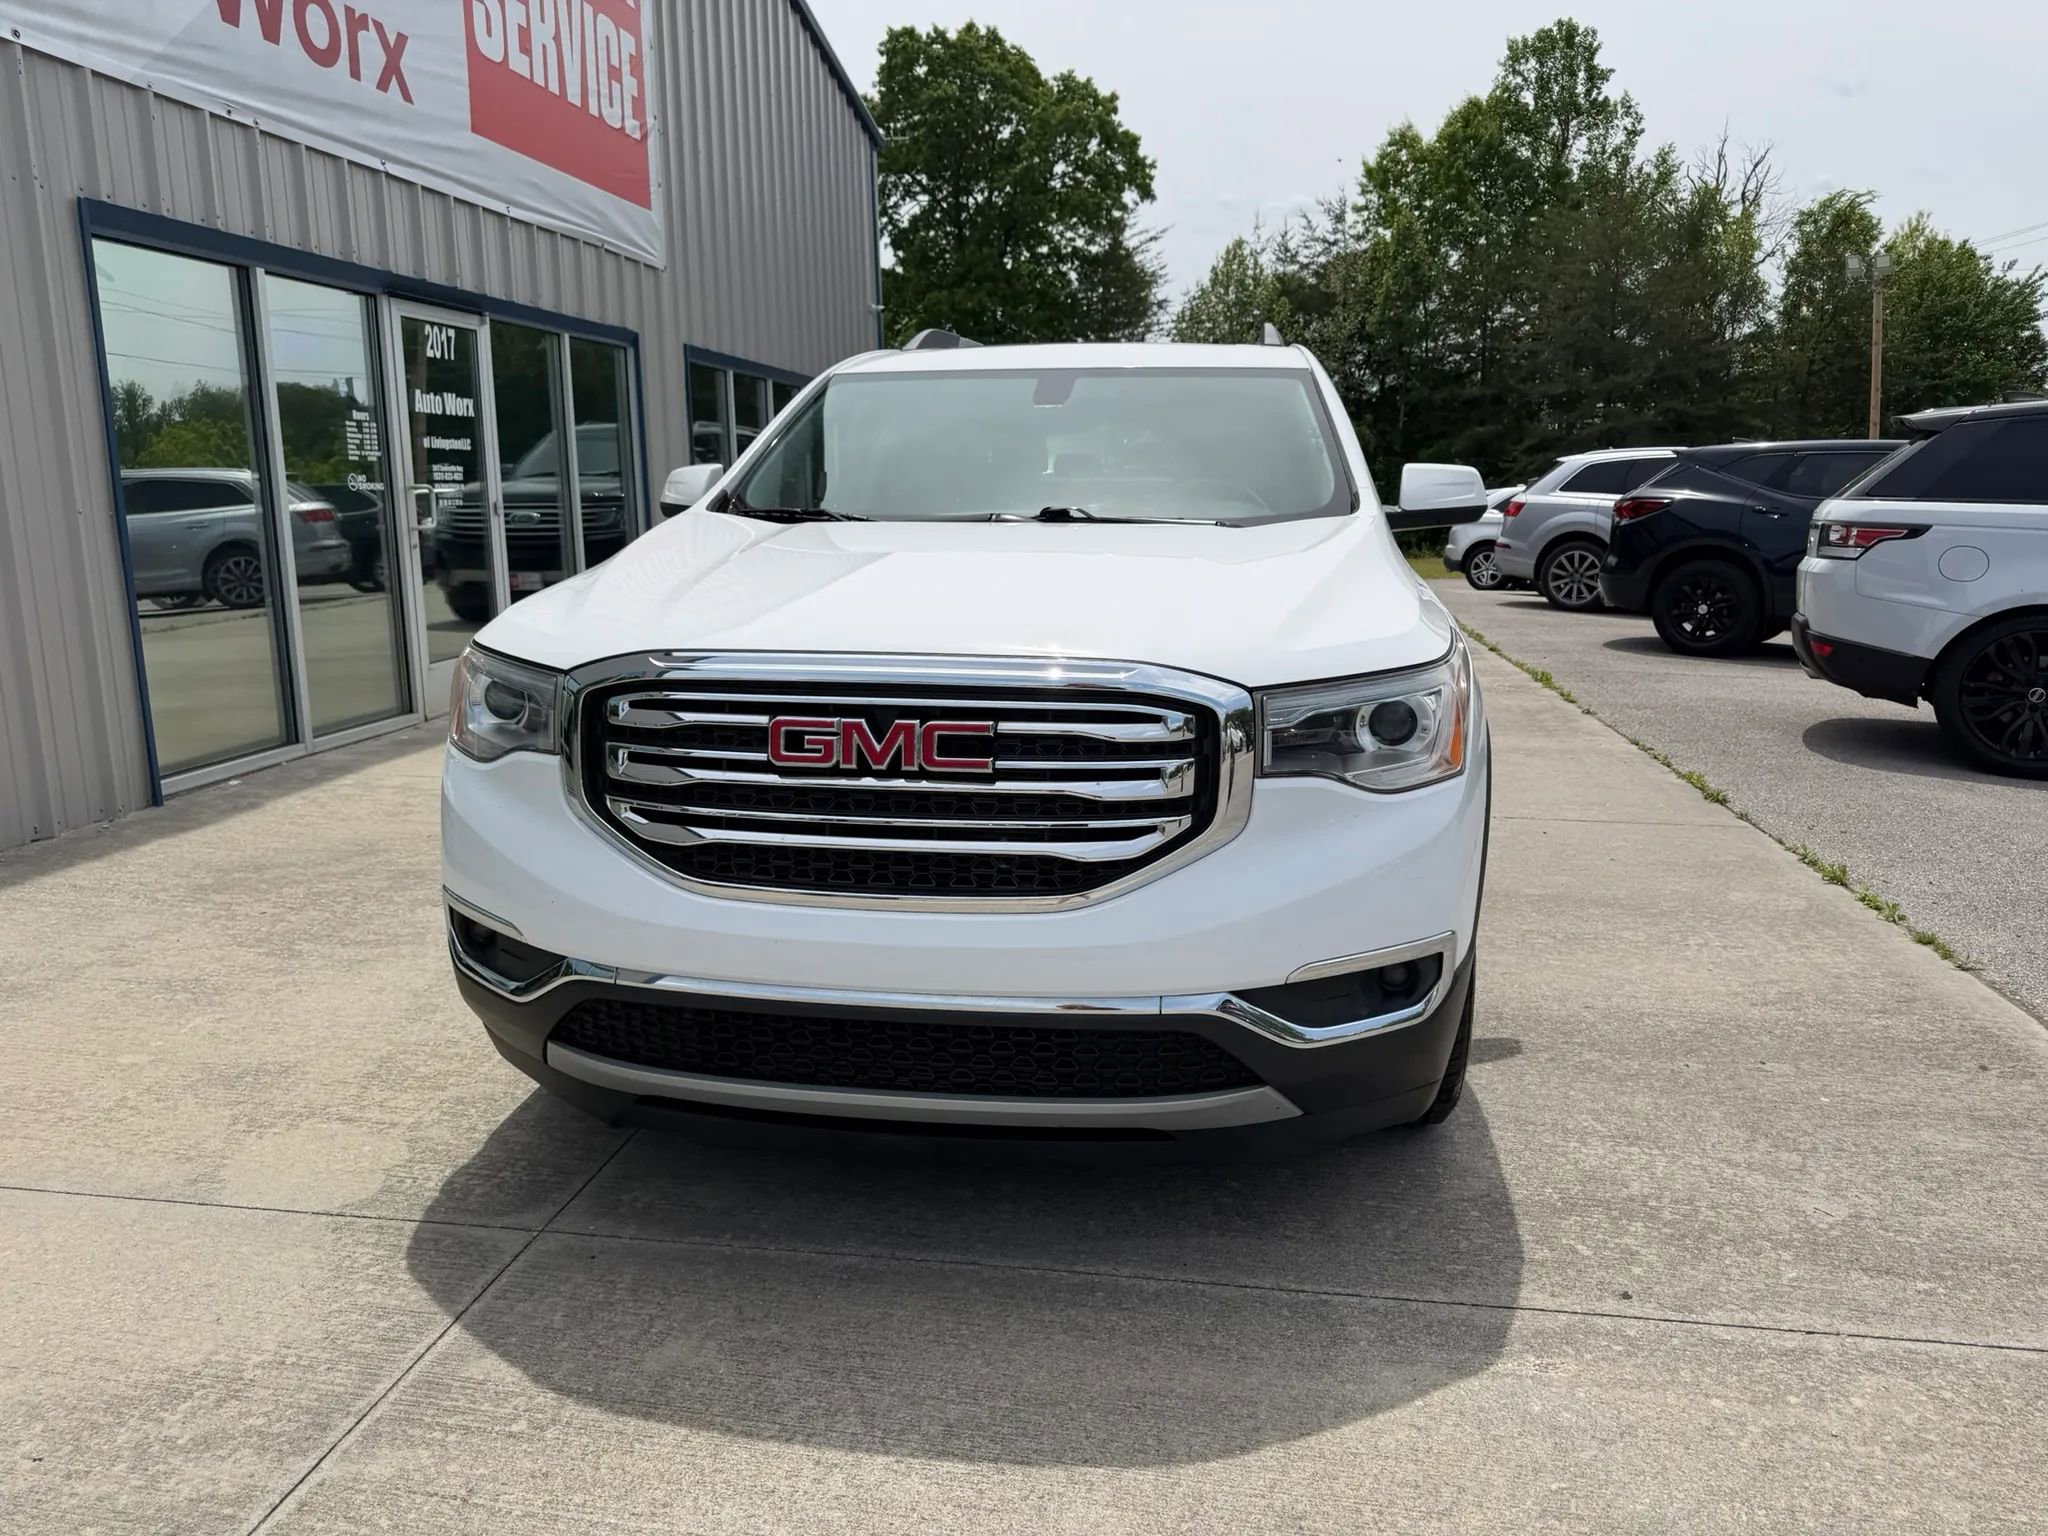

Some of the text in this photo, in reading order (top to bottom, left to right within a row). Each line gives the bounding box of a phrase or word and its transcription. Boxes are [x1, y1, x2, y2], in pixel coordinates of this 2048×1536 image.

[425, 324, 456, 361] 2017
[414, 388, 475, 417] Auto Worx
[358, 474, 367, 483] NO
[358, 482, 385, 491] SMOKING
[768, 716, 995, 773] GMC
